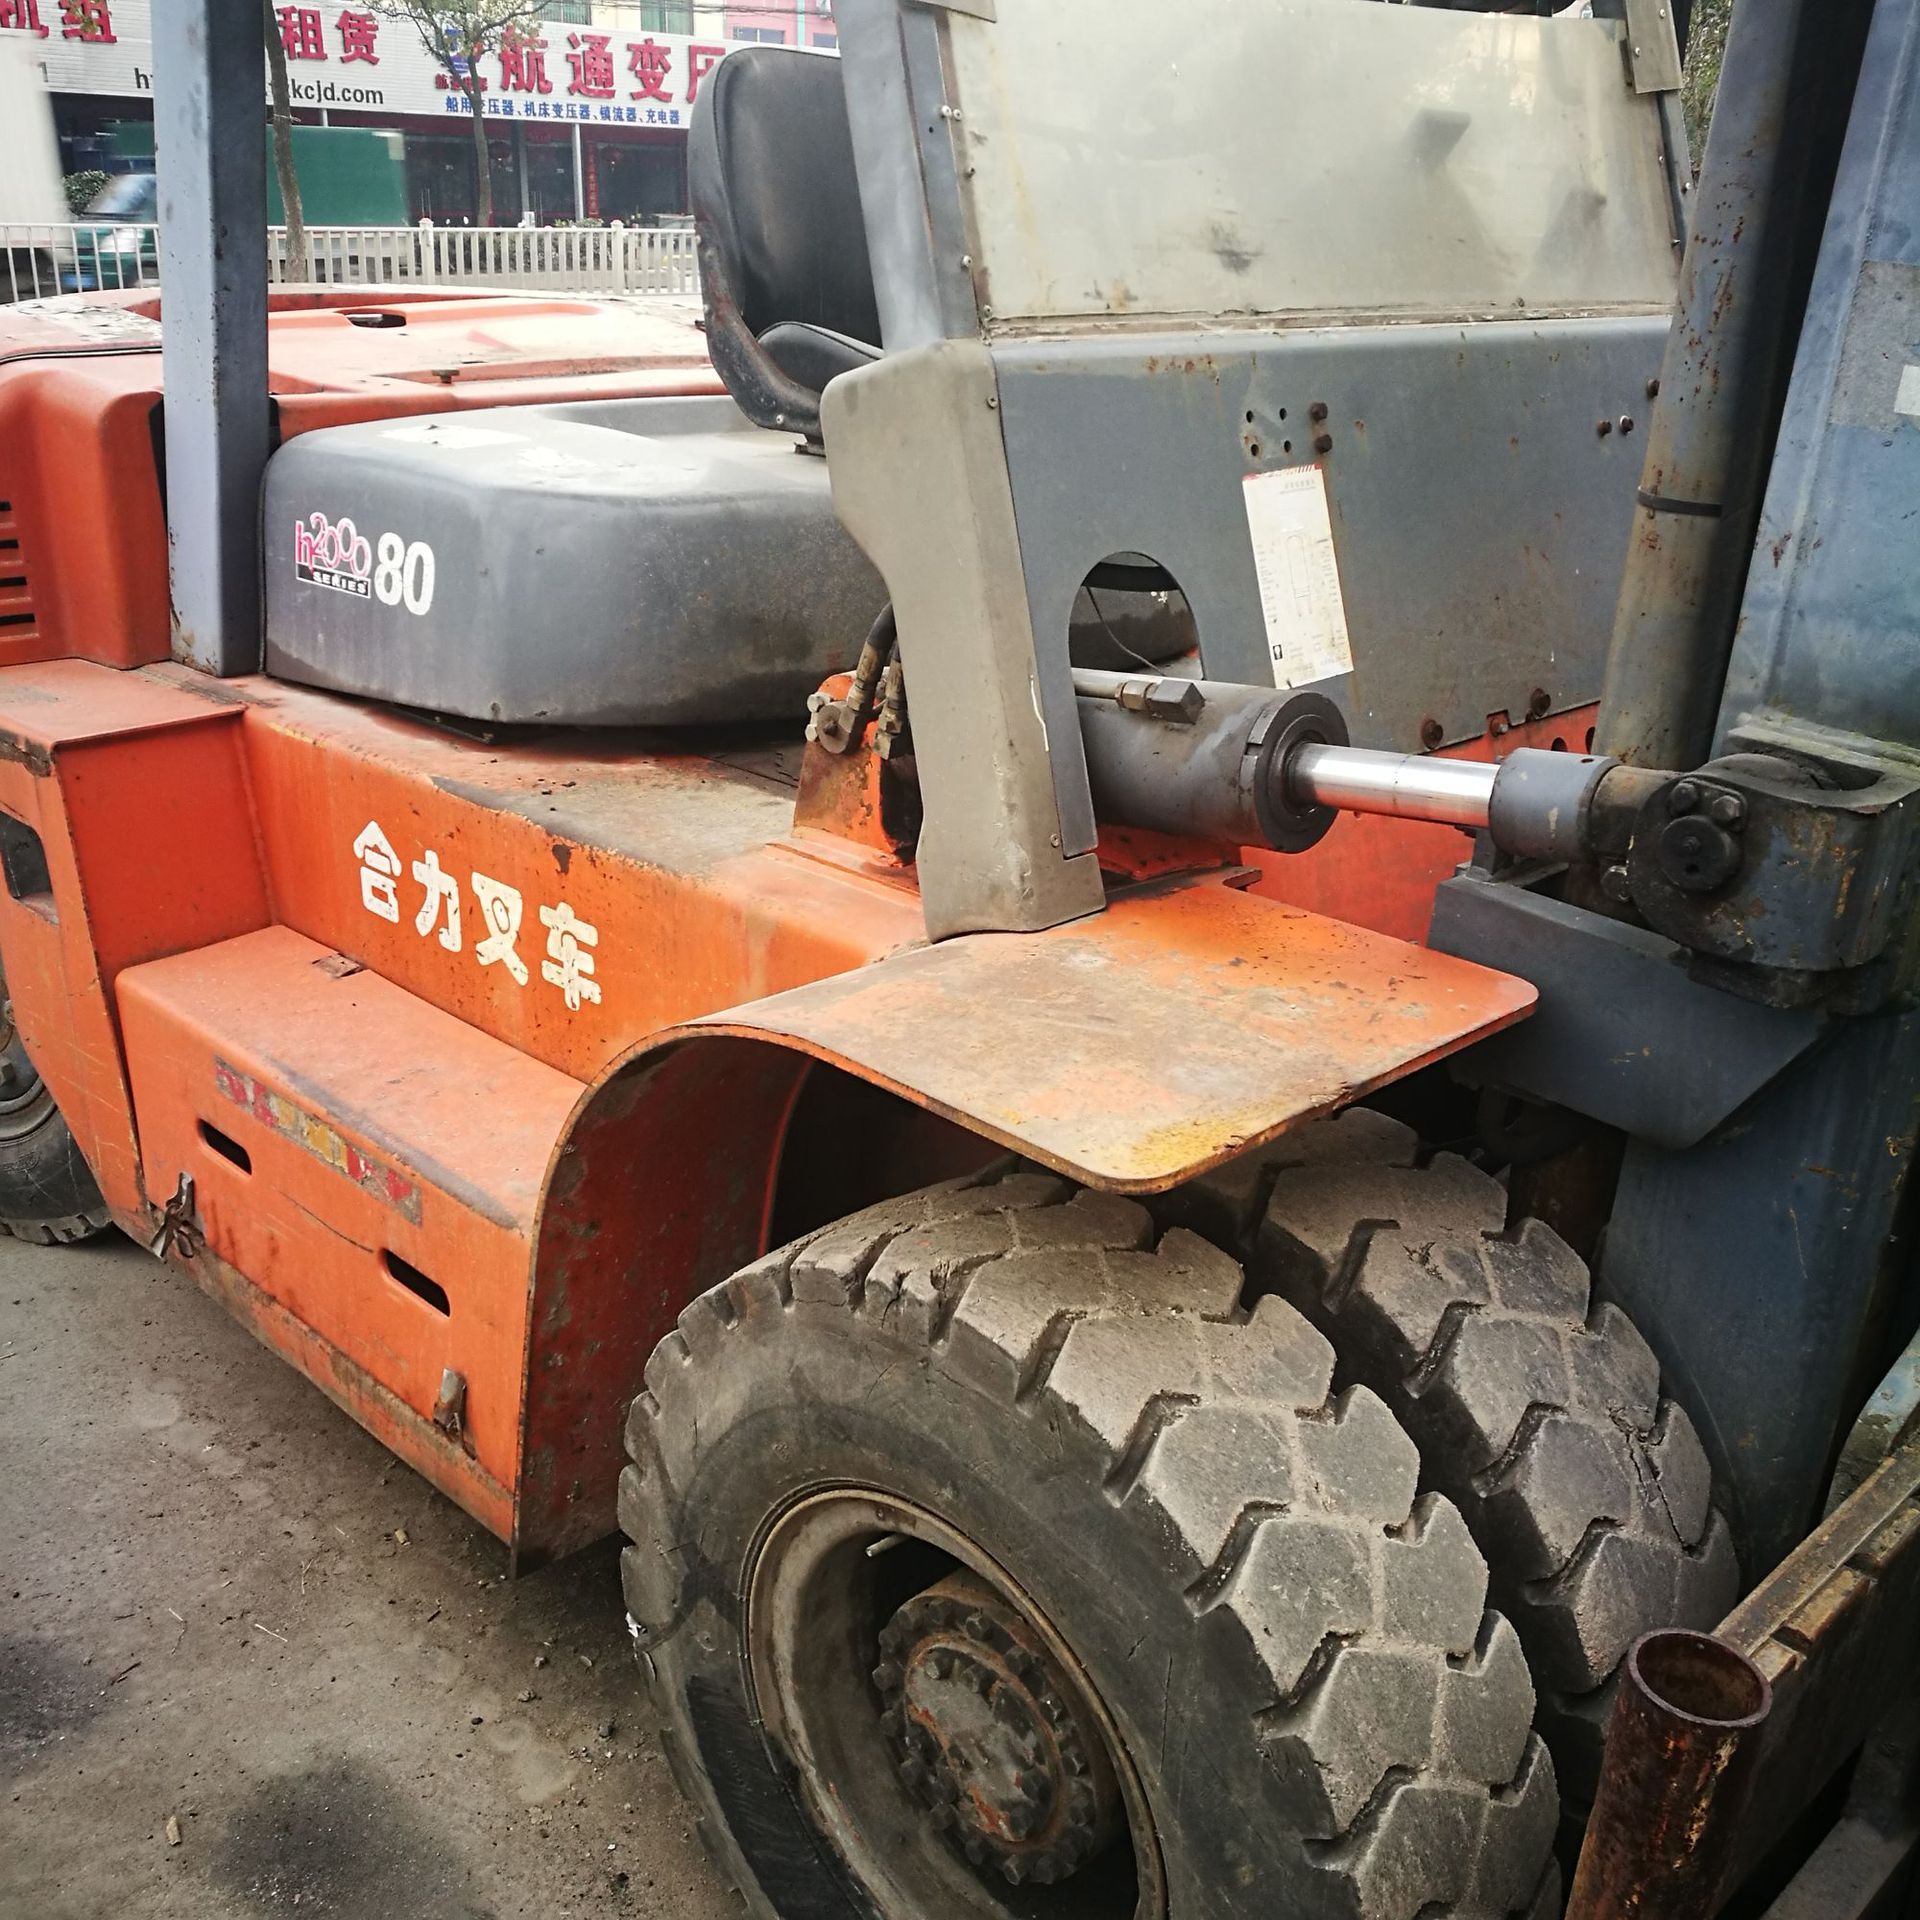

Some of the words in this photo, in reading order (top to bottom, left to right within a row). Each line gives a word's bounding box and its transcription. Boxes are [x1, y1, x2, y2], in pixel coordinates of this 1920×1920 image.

[276, 5, 380, 65] 租赁
[287, 78, 384, 105] kcjd.com
[312, 570, 368, 595] SERIES
[374, 532, 436, 616] 80
[353, 820, 602, 1012] 合力叉车
